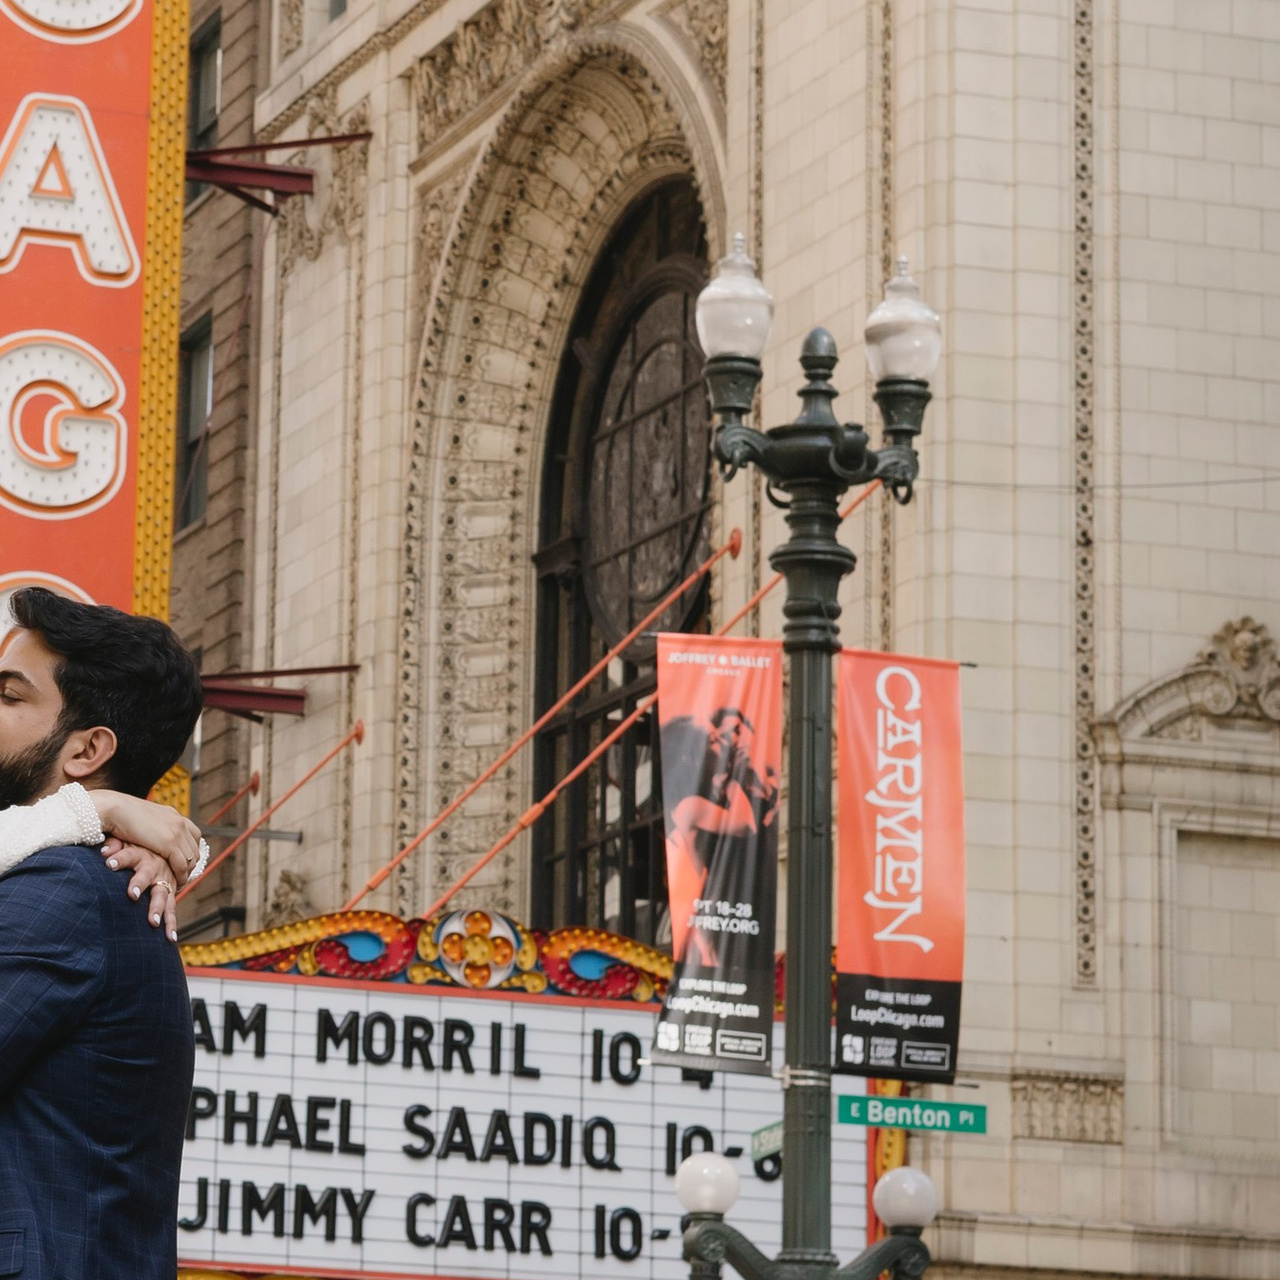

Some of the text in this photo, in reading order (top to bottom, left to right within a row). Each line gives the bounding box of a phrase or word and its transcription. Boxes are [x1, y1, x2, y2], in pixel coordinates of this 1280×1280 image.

[668, 652, 771, 669] JOFFREY BALLET
[864, 666, 934, 953] CARMEN
[666, 994, 759, 1019] LoopChicago.com
[851, 1005, 945, 1030] LoopChicago.com
[191, 998, 267, 1058] AM
[317, 1008, 540, 1079] MORRIL
[185, 1086, 365, 1156] PHAEL
[402, 1104, 622, 1172] SAADIQ
[851, 1100, 974, 1128] E Benton Pl
[178, 1177, 671, 1261] JIMMY CARR 10-
